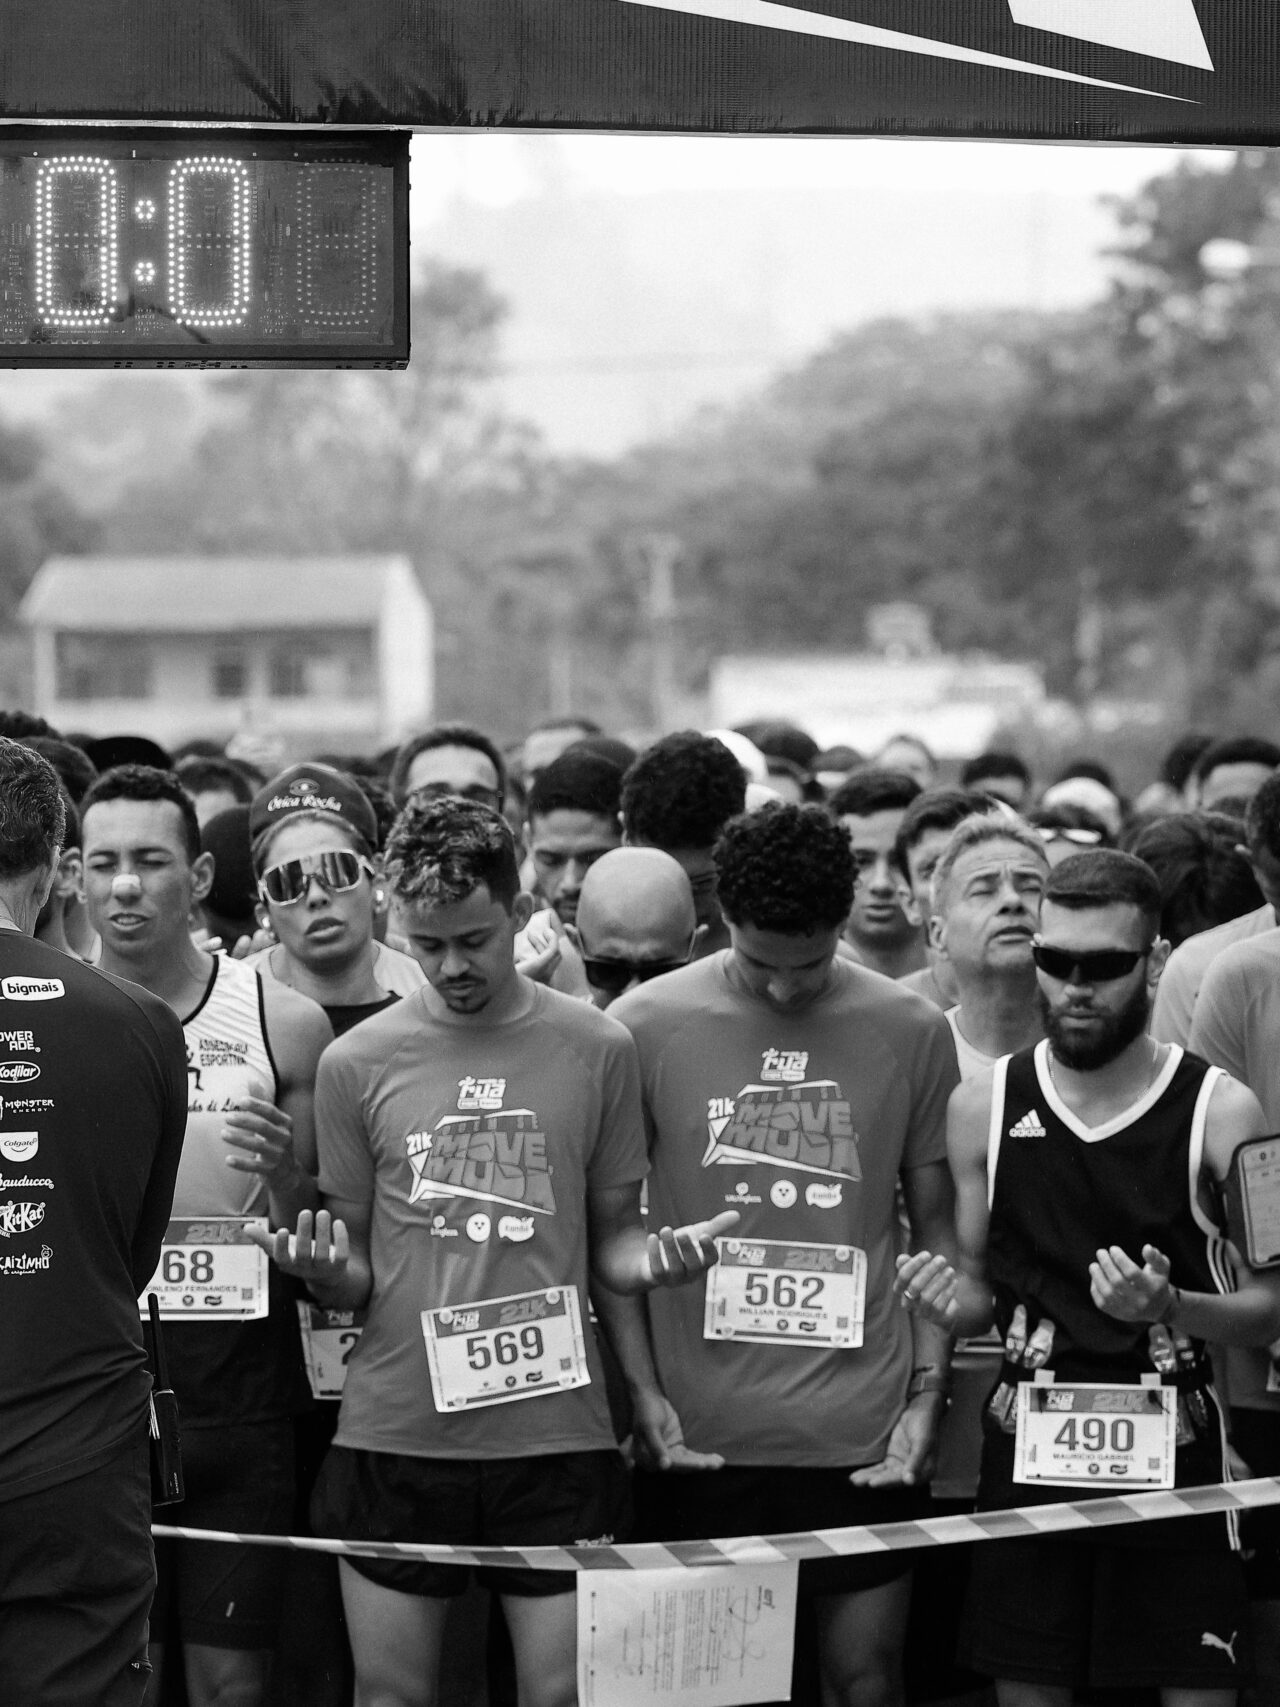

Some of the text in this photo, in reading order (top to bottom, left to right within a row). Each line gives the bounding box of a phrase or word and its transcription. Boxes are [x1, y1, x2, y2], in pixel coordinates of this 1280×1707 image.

[7, 982, 59, 995] bigmais
[9, 1040, 35, 1051] ADE
[5, 1099, 55, 1109] MONSTER
[707, 1097, 736, 1119] 21k
[3, 1140, 34, 1148] Colgate
[405, 1131, 433, 1156] 21k
[2, 1202, 43, 1233] KitKat
[163, 1250, 214, 1283] 68
[745, 1272, 825, 1309] 562
[466, 1325, 544, 1370] 569
[1054, 1418, 1134, 1451] 490
